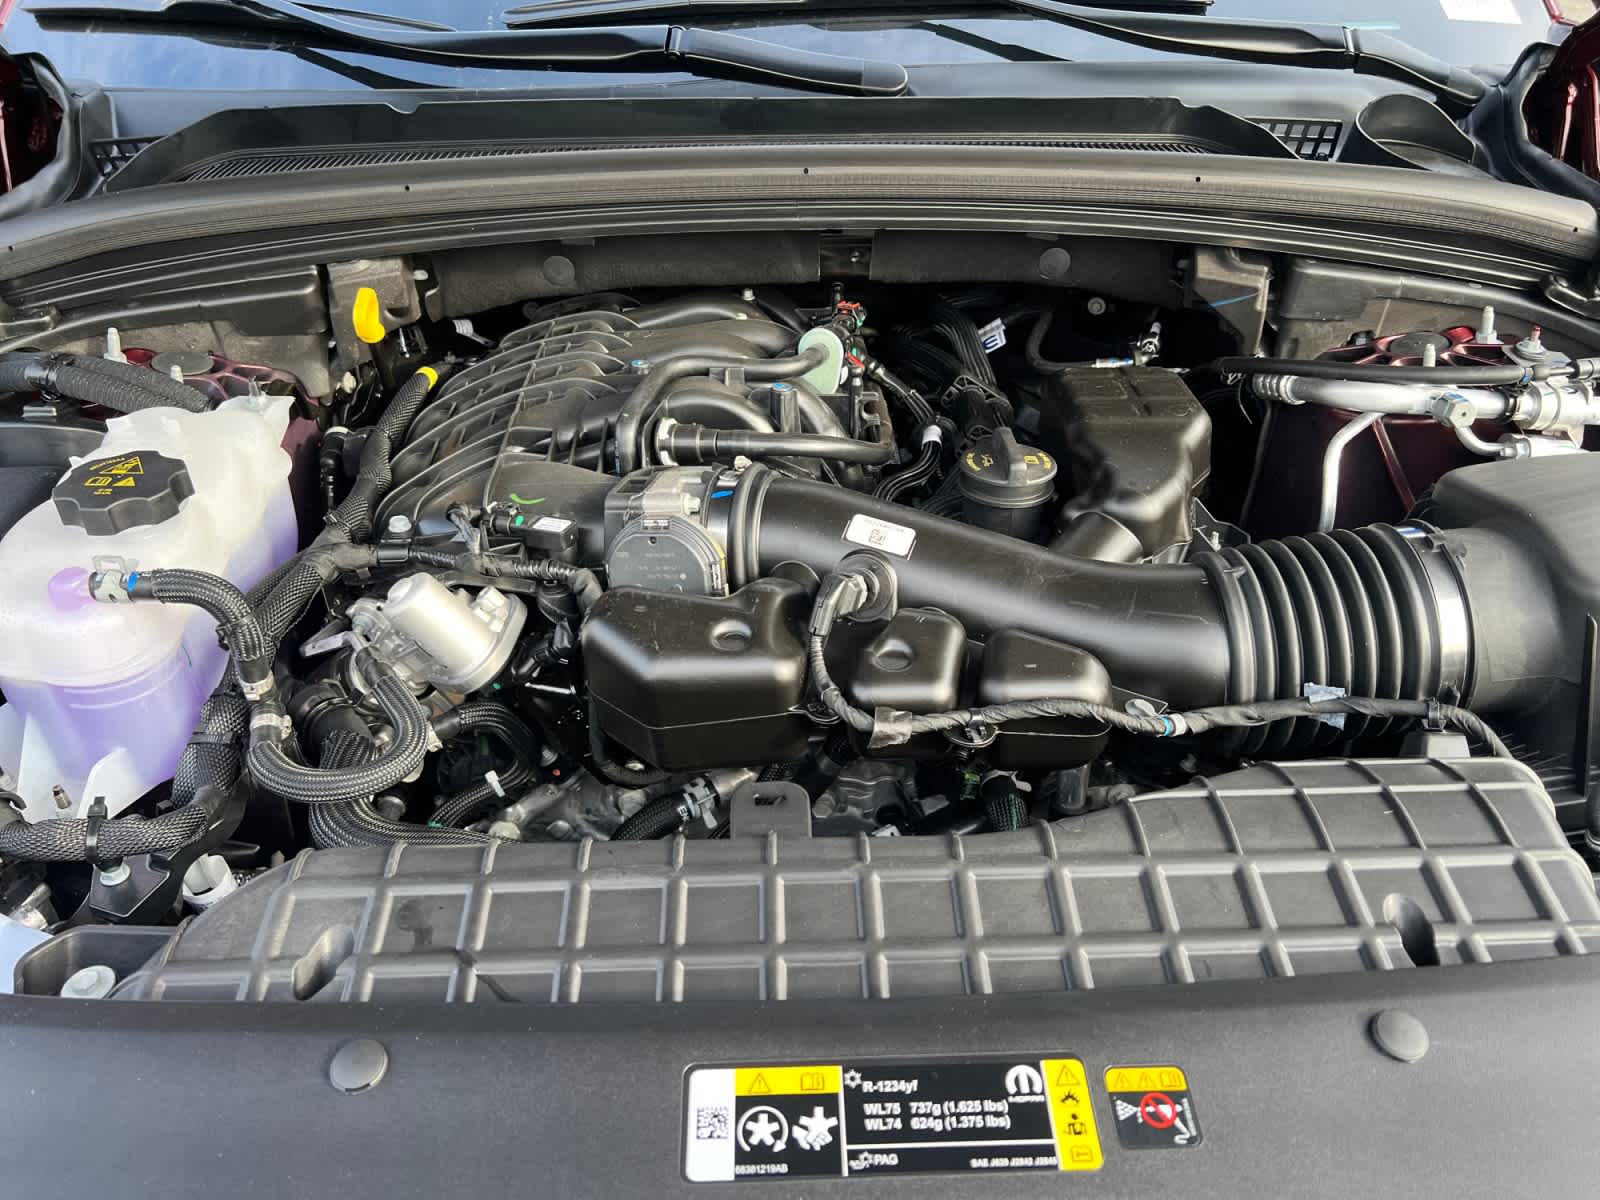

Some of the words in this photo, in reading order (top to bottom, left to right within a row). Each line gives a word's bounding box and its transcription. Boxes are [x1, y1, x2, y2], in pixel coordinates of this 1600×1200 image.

[862, 1079, 918, 1094] R-1234yf
[863, 1102, 901, 1115] WL75
[910, 1101, 941, 1116] 737g
[943, 1100, 982, 1115] (1.625
[983, 1099, 1009, 1114] lbs)
[864, 1117, 902, 1131] WL74
[911, 1116, 943, 1132] 624g
[944, 1115, 984, 1131] (1.375
[985, 1114, 1011, 1129] lbs)
[873, 1153, 899, 1167] PAG
